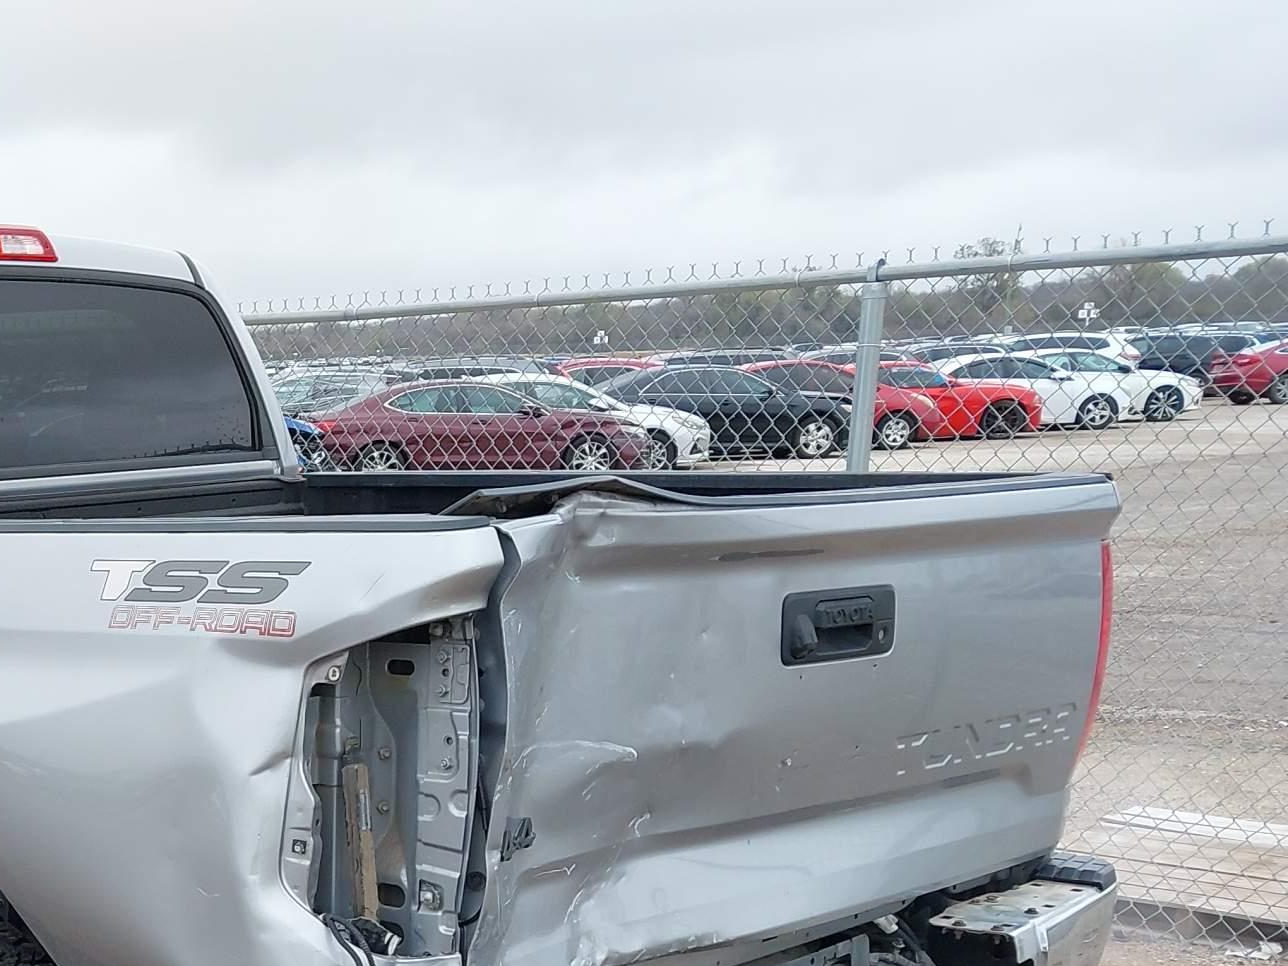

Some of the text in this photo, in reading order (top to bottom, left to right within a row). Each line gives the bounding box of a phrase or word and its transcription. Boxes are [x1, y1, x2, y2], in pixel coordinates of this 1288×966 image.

[90, 559, 312, 604] TSS
[108, 604, 298, 638] OFF-ROAD
[824, 606, 873, 625] TOYOTA
[896, 702, 1077, 776] TUNDRA
